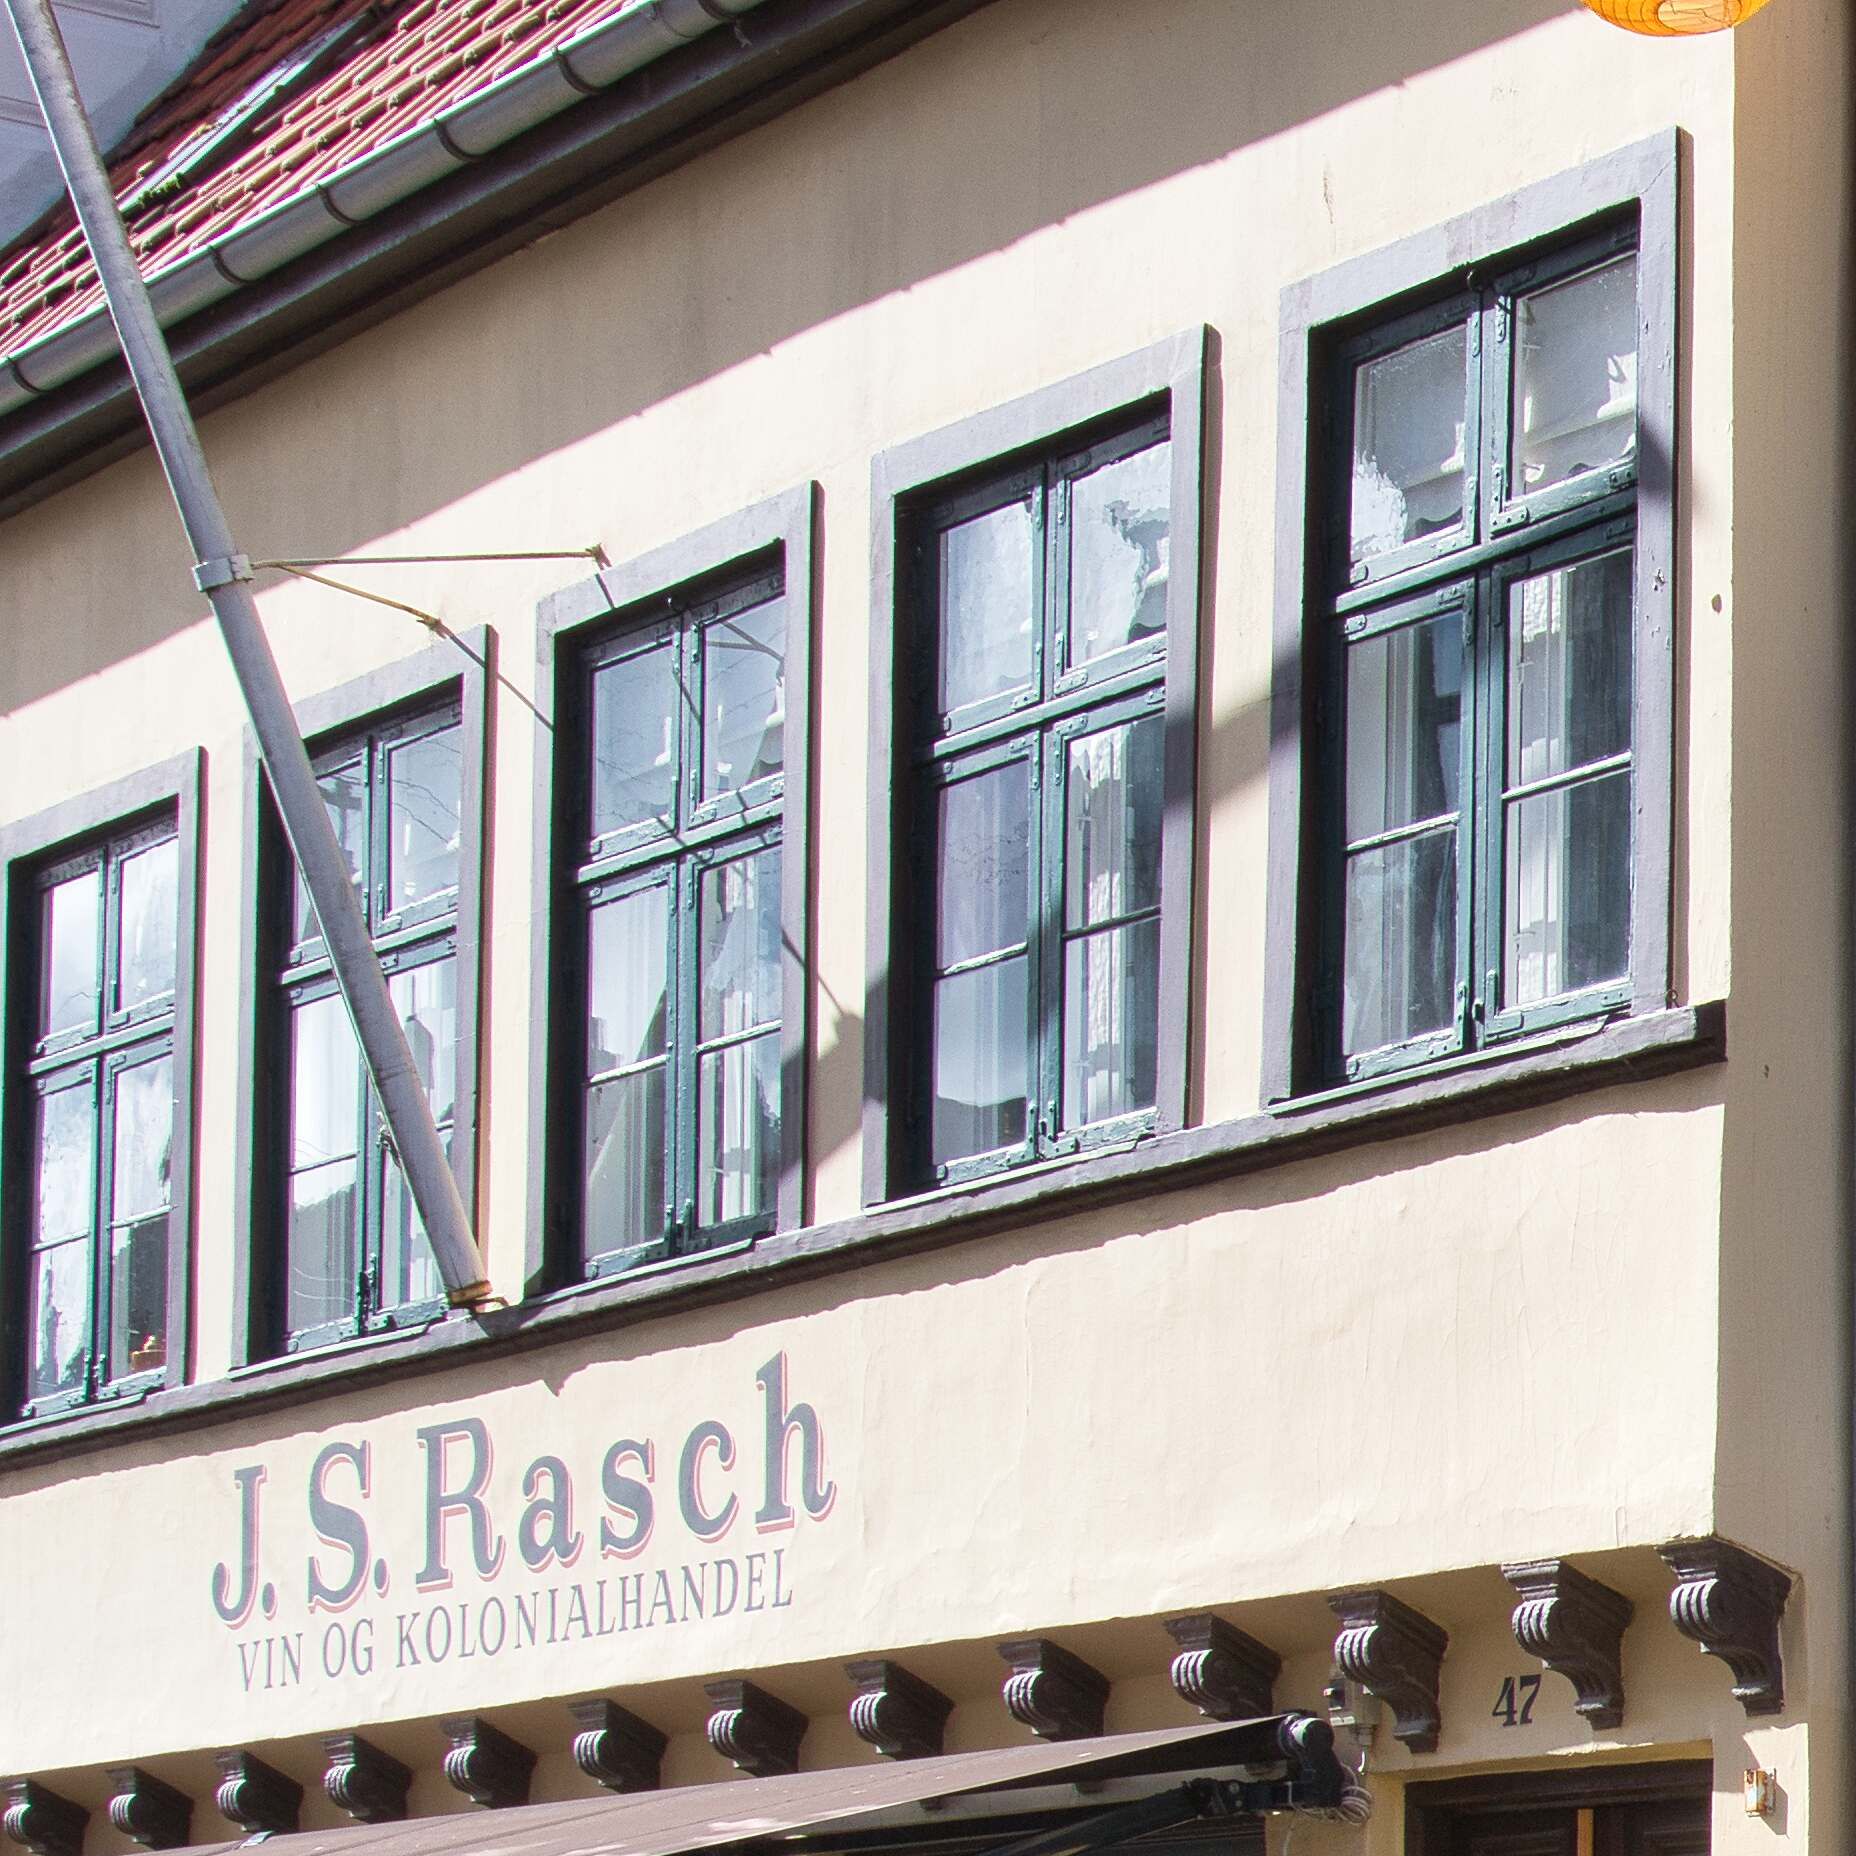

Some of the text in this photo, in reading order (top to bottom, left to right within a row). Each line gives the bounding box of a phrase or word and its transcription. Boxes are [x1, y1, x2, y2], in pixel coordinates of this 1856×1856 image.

[416, 1351, 836, 1592] Rasch
[238, 1548, 793, 1691] VIN OG KOLONIALHANDEL
[1492, 1674, 1542, 1726] 47
